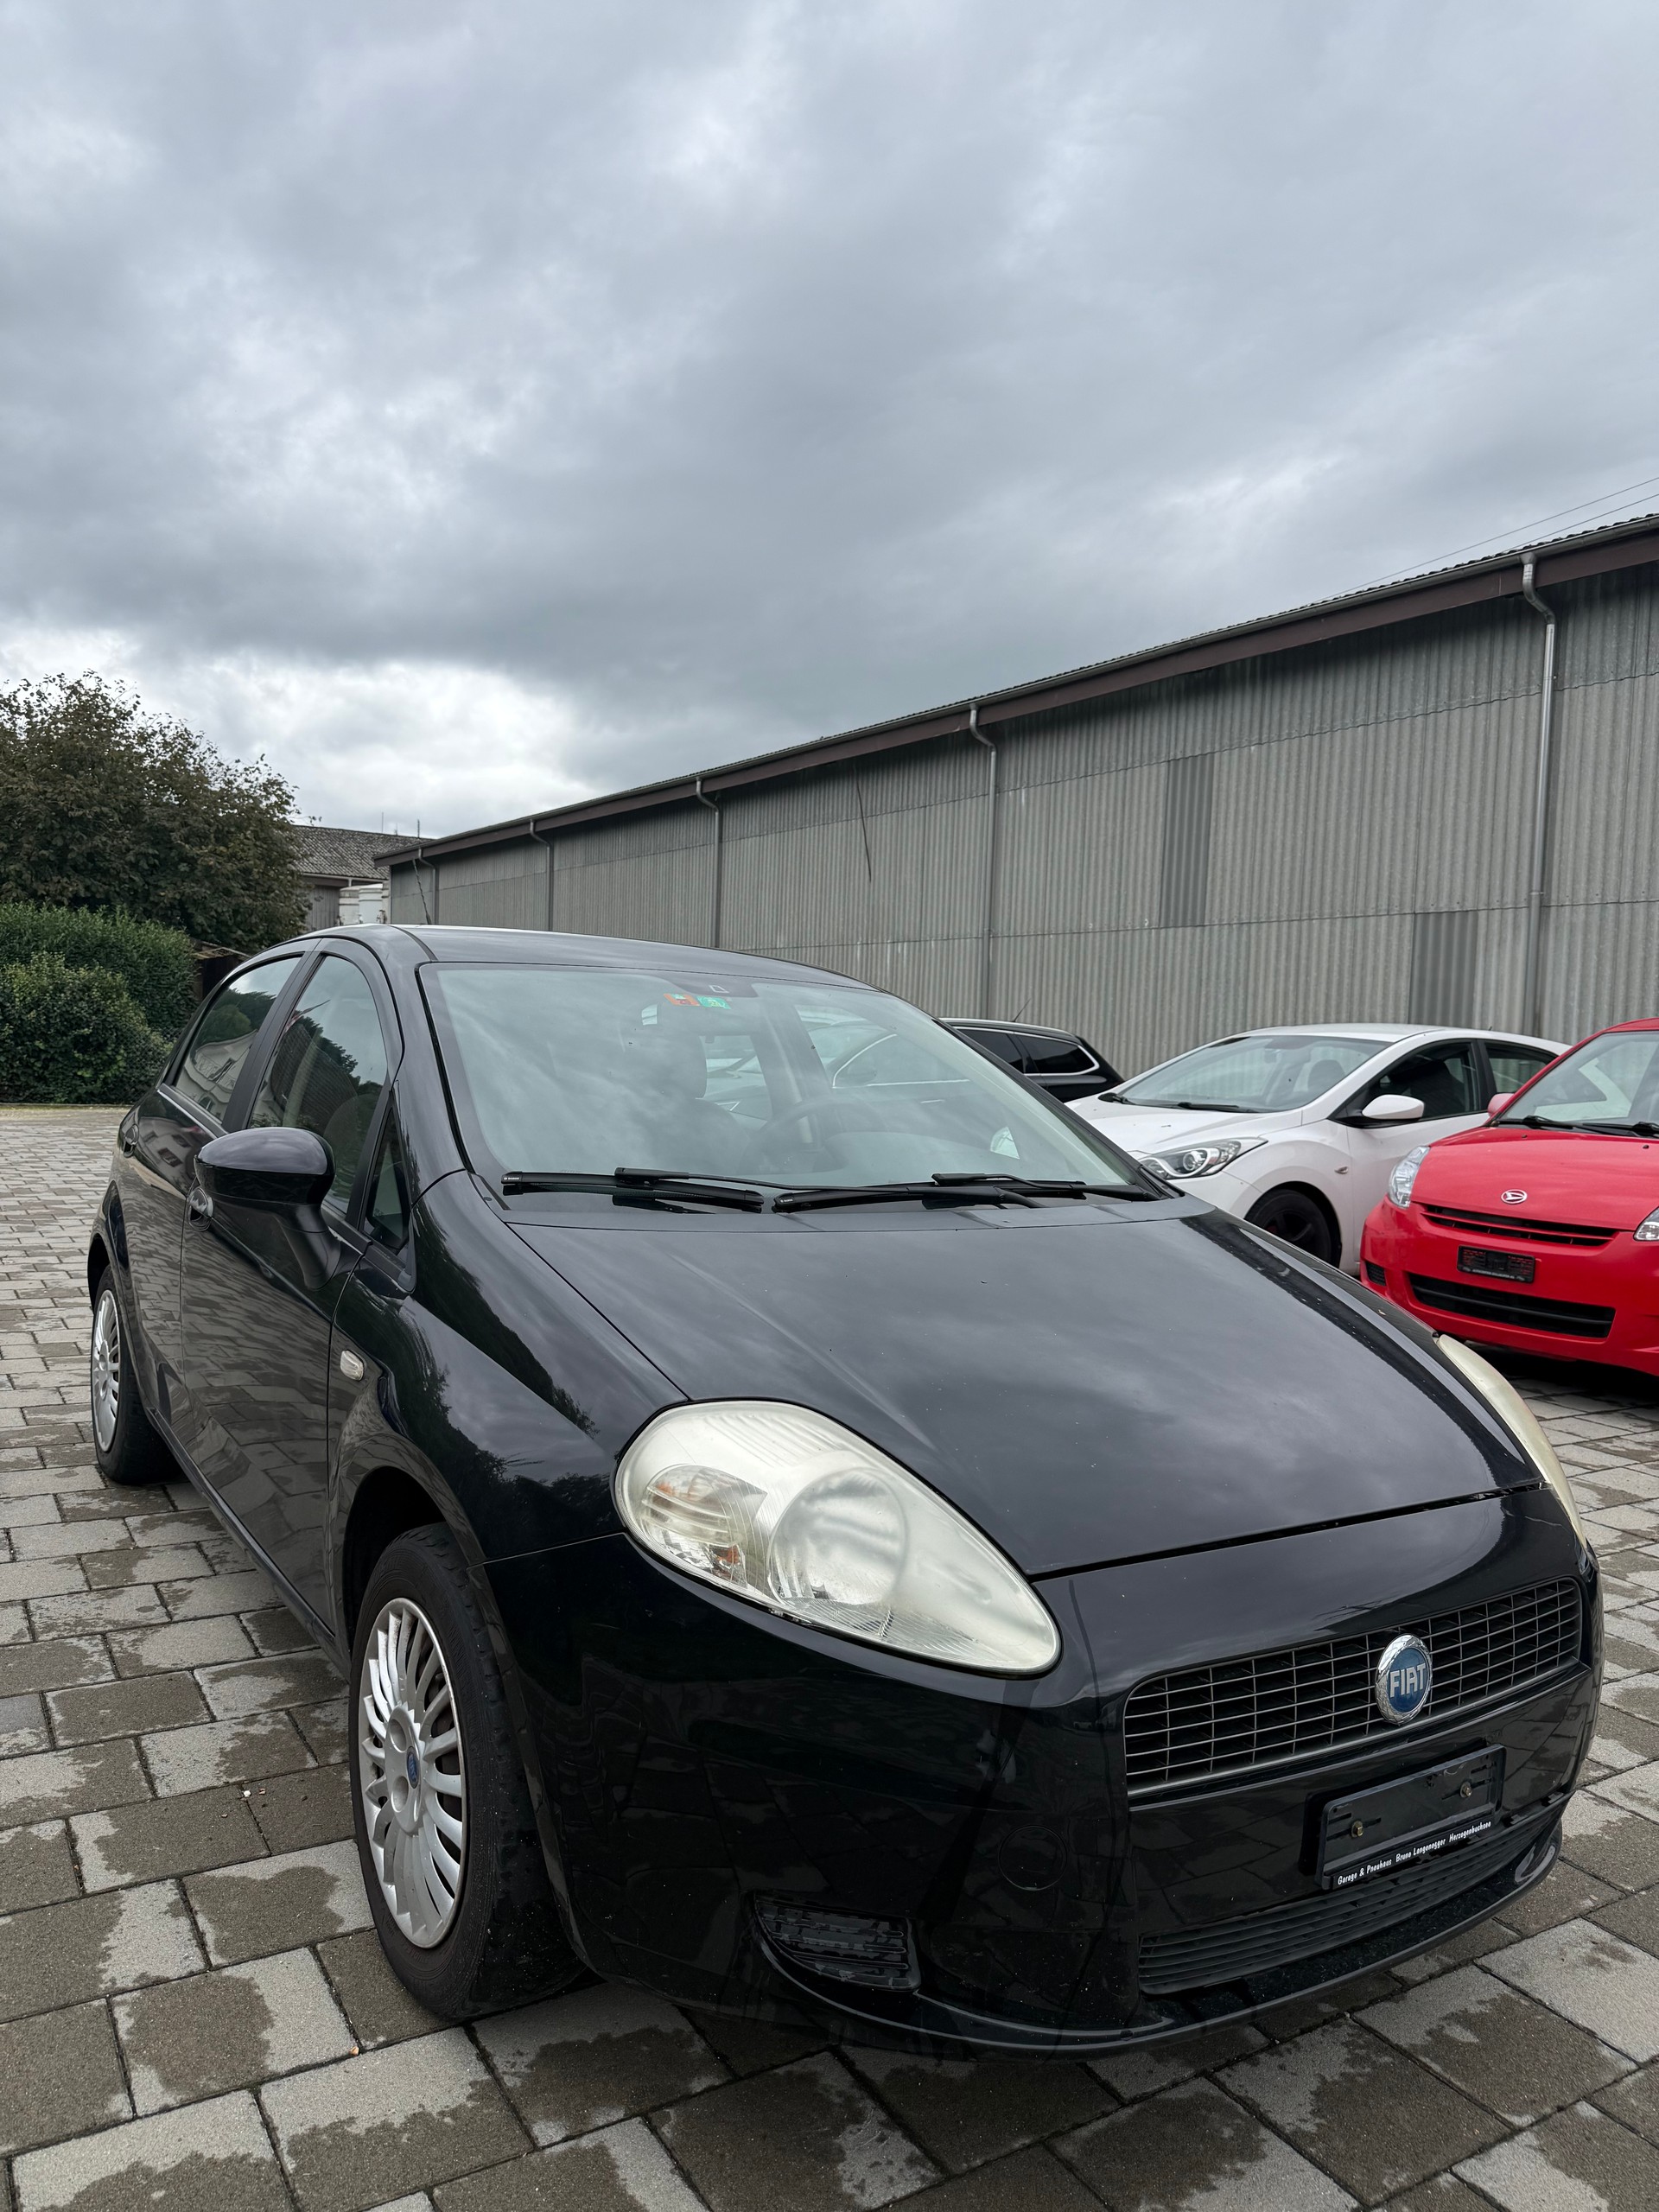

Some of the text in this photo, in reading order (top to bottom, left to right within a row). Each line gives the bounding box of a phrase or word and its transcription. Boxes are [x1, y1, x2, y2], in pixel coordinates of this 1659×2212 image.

[1389, 1663, 1426, 1698] FIAT
[1338, 1872, 1357, 1885] Garage
[1359, 1867, 1364, 1877] &
[1366, 1859, 1392, 1874] Pneuhaus
[1395, 1852, 1412, 1863] Bruno
[1413, 1839, 1446, 1855] Langenegger
